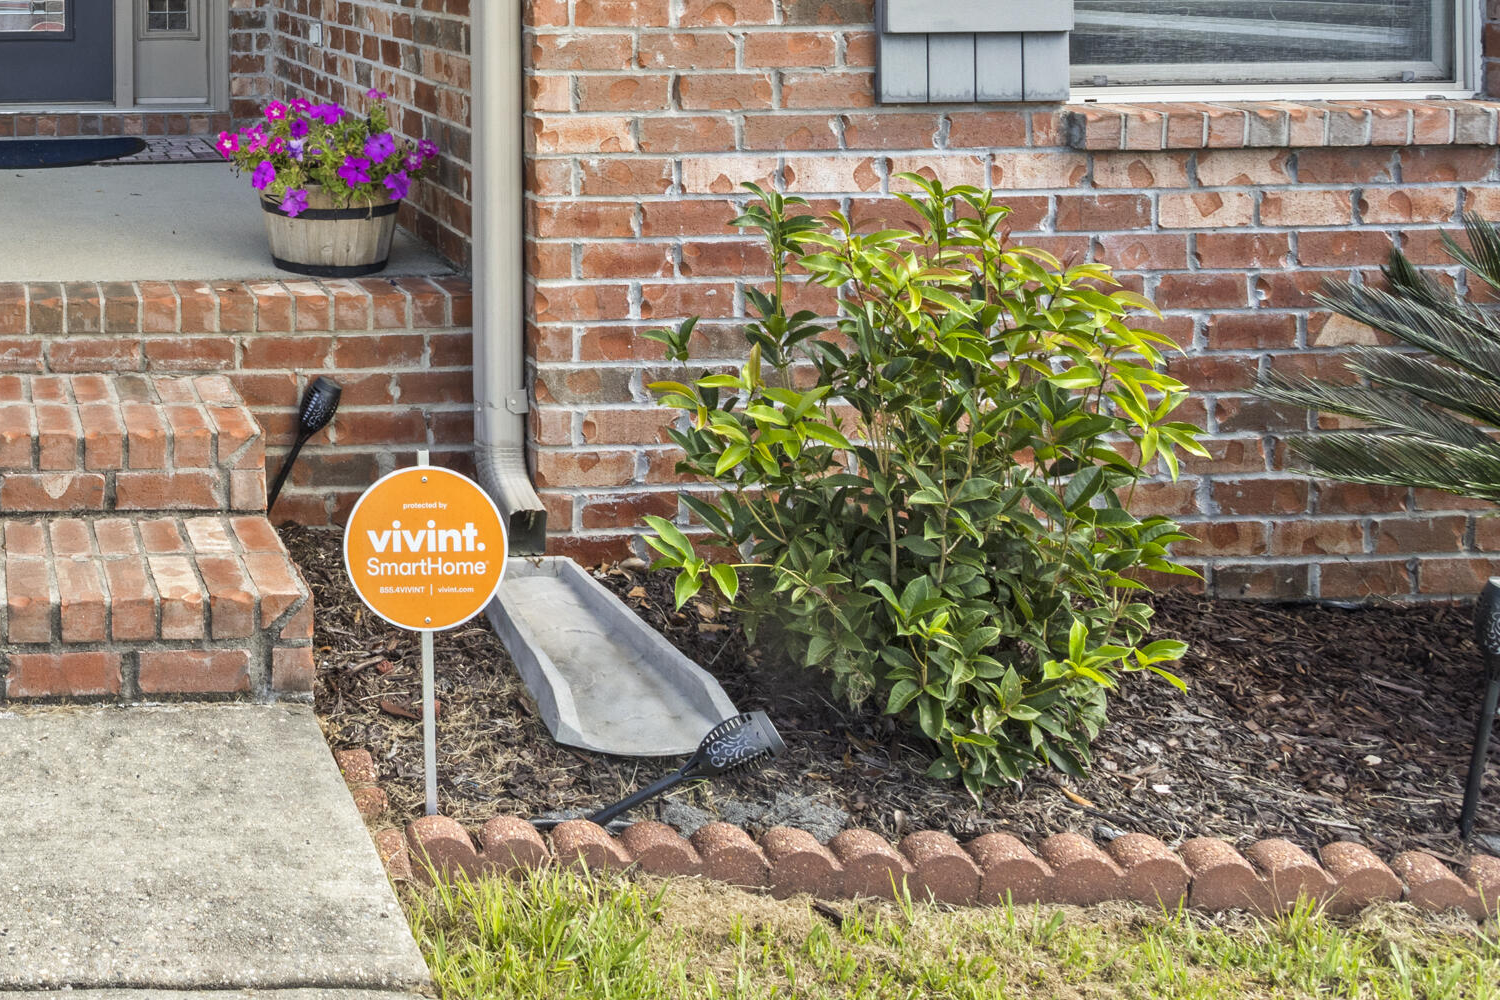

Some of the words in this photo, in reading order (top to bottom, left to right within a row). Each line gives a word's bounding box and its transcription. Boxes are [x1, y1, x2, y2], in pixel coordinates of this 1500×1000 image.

[402, 502, 437, 510] protected
[438, 502, 447, 510] by
[366, 519, 486, 553] vivint.
[379, 586, 425, 594] 855.4VIVINT
[437, 585, 475, 593] vivint.com
